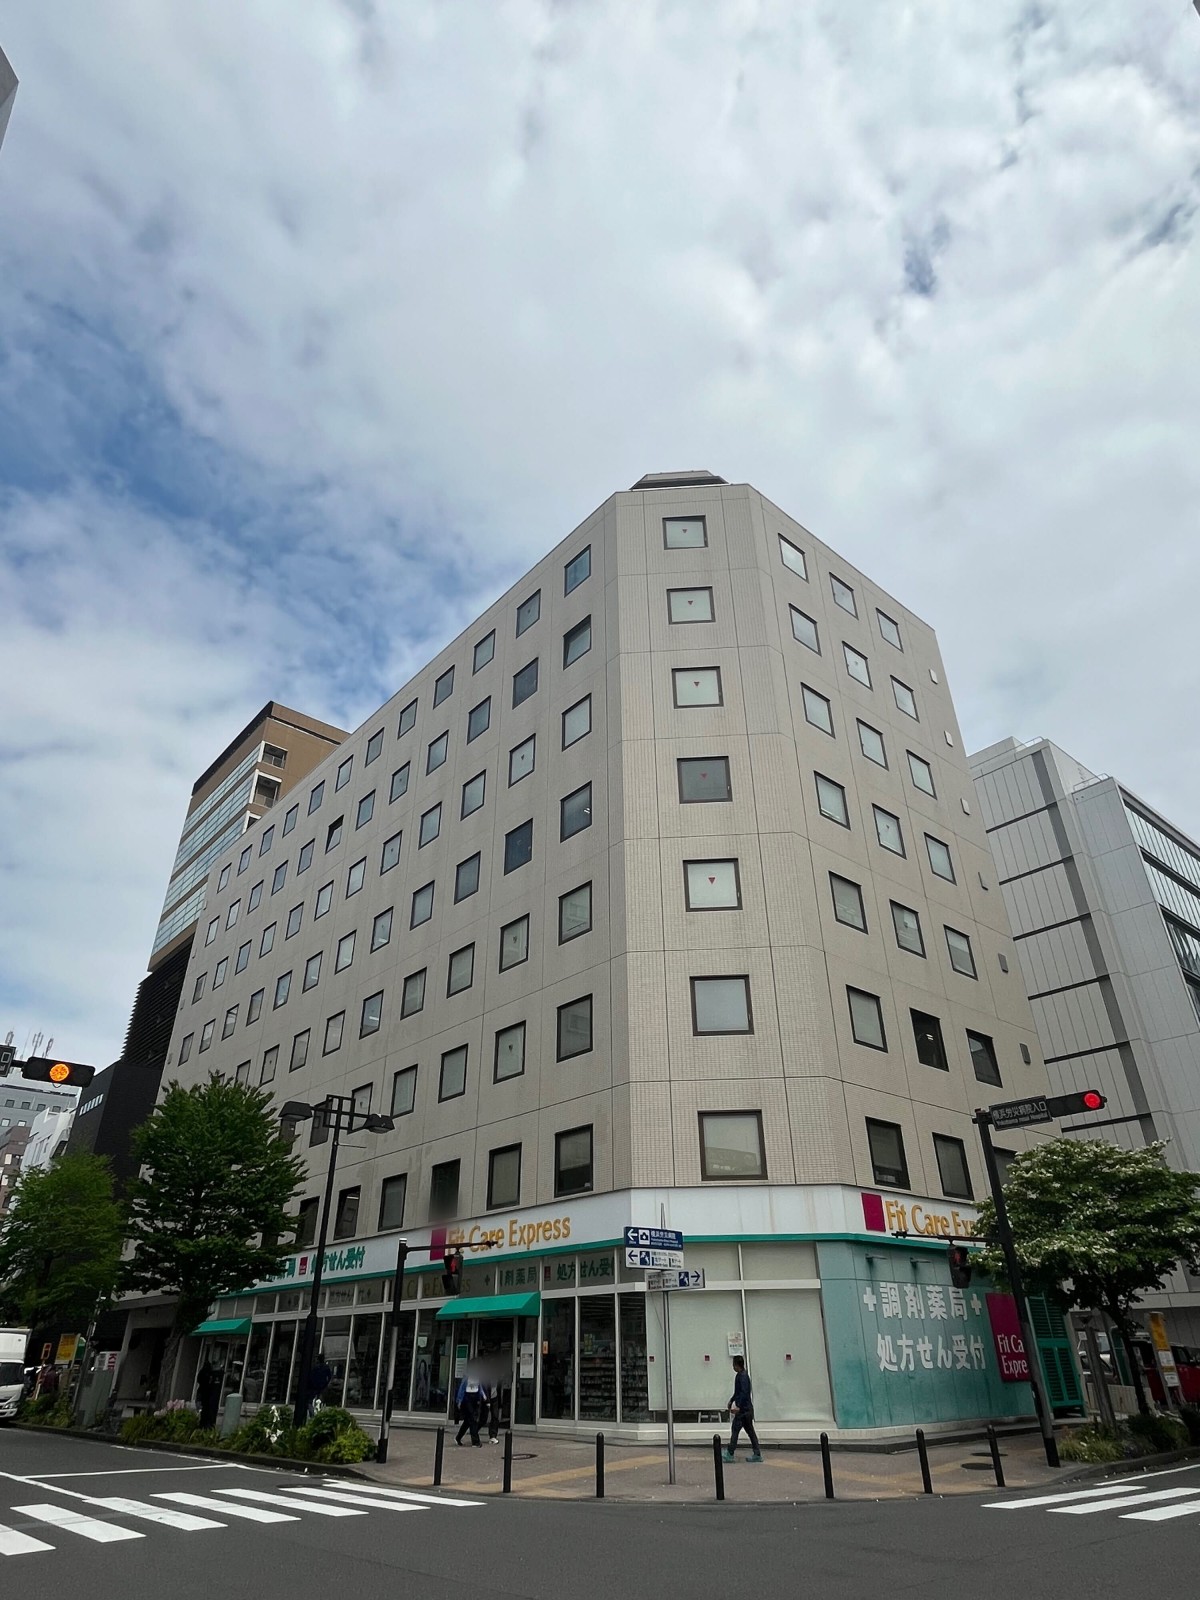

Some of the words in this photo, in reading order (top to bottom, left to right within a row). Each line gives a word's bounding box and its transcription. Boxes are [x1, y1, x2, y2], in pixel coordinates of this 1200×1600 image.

[469, 1224, 505, 1253] Care
[509, 1217, 571, 1250] Express
[885, 1200, 909, 1232] Fit
[911, 1205, 950, 1236] Care
[500, 1266, 537, 1287] 剤薬局
[880, 1282, 968, 1321] 調剤薬局
[877, 1333, 986, 1373] 処方せん受付
[997, 1333, 1010, 1353] Fit
